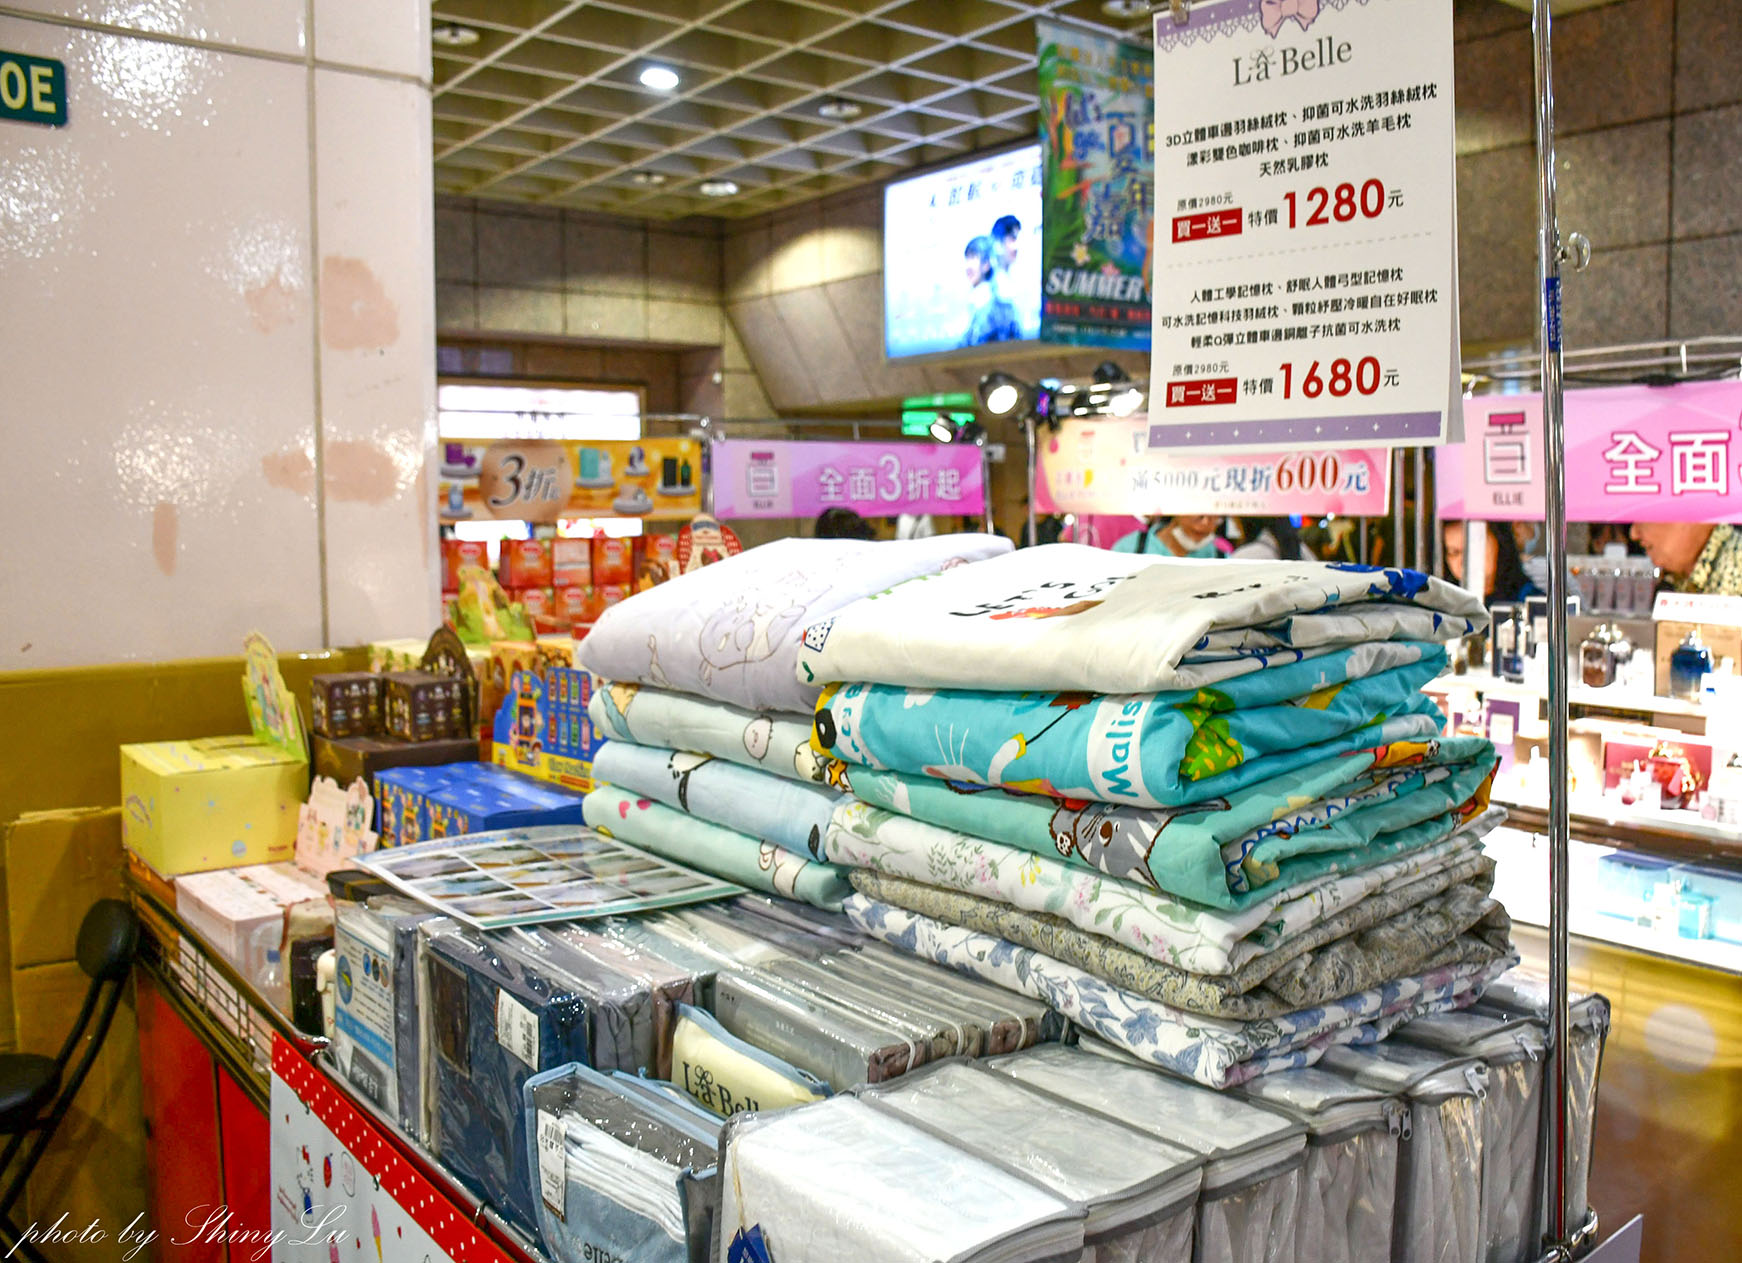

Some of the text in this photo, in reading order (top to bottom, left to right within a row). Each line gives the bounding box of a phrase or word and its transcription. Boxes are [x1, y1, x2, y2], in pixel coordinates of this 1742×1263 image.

[1280, 35, 1352, 76] Belle
[1259, 151, 1329, 178] 天然乳膠枕
[1176, 191, 1234, 211] 原價2980元
[1176, 215, 1238, 240] 買一送一
[1045, 267, 1144, 302] SUMMER
[1172, 360, 1230, 376] 原價2980元
[1171, 383, 1232, 404] 買一送一
[1602, 430, 1742, 496] 全面
[819, 453, 963, 502] 全面3折起
[1493, 492, 1524, 506] ELLIE
